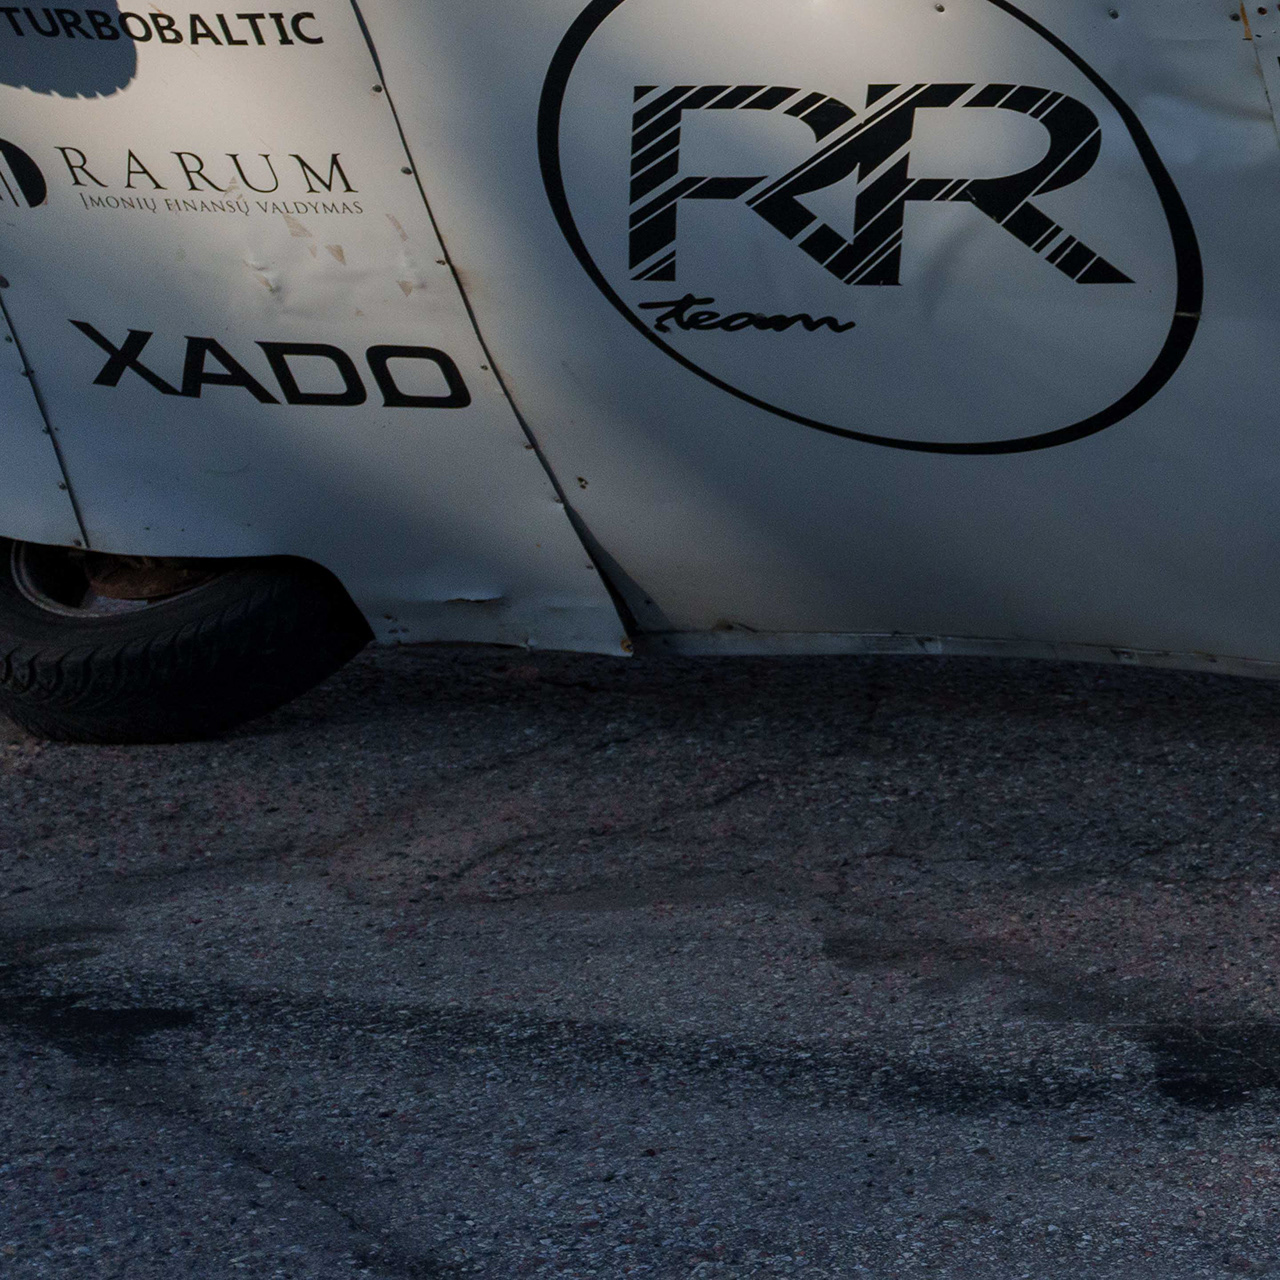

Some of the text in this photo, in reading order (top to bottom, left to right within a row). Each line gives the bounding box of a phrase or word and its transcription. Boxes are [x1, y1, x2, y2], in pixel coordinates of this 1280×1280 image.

[0, 6, 325, 46] TURBOBALTIC
[54, 146, 359, 194] RARUM
[629, 83, 1136, 286] RR
[256, 200, 364, 215] VALDYMAS
[638, 293, 856, 333] team
[68, 319, 472, 409] XADO
